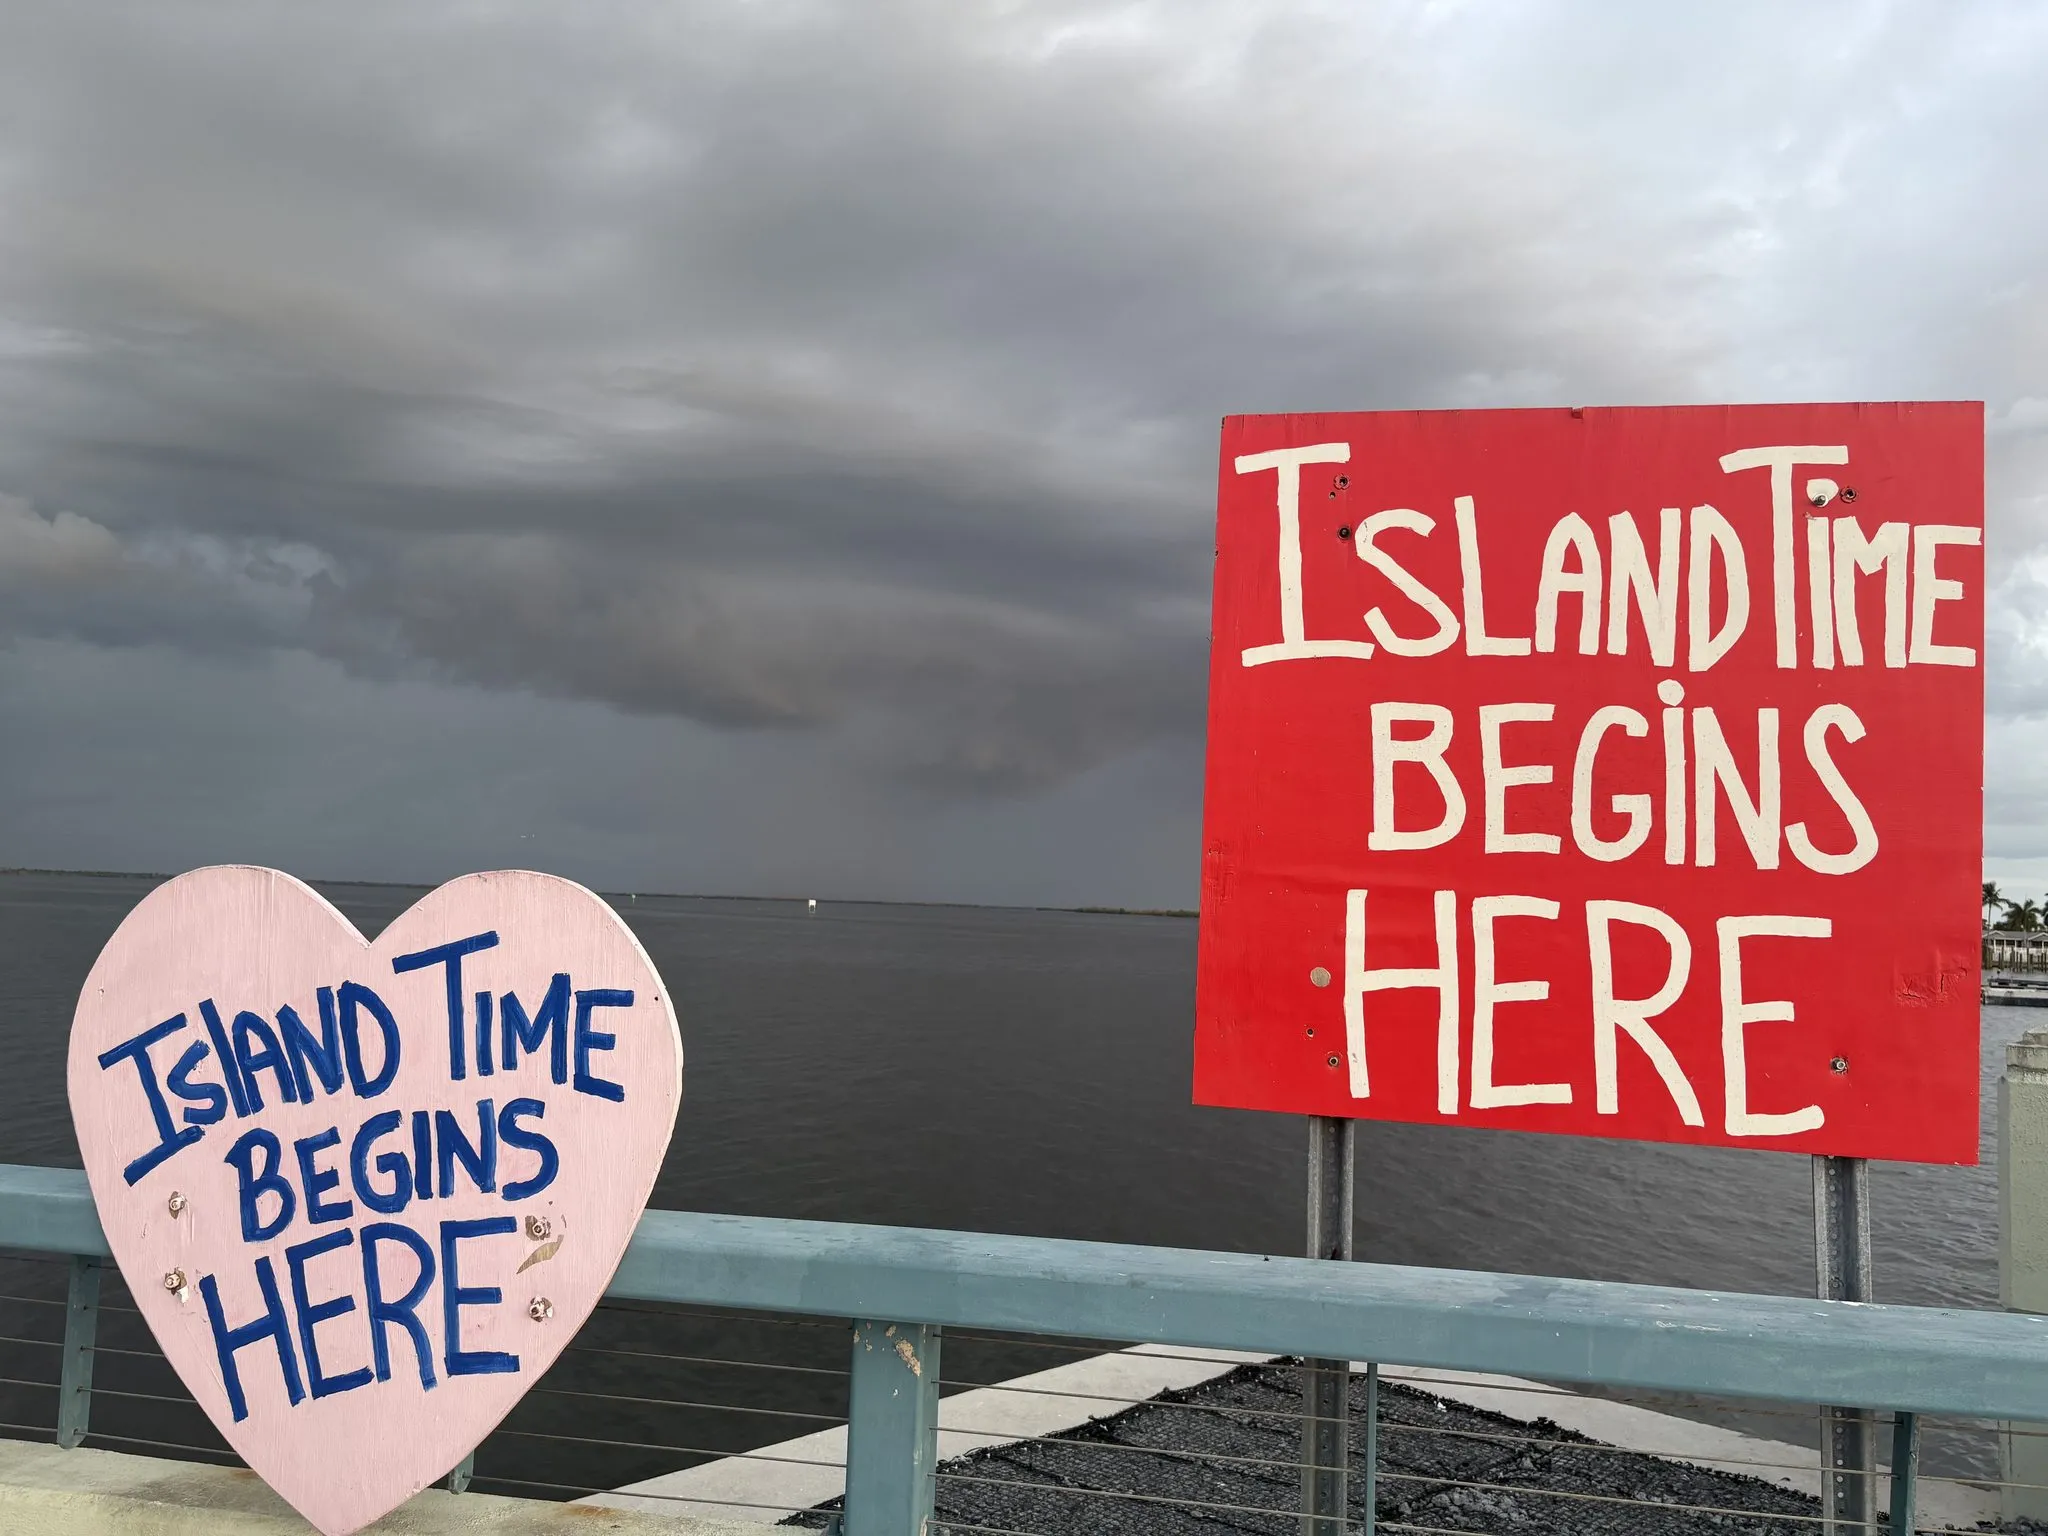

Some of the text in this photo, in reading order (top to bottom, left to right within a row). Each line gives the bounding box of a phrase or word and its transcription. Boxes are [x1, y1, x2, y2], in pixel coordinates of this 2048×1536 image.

[1234, 442, 1750, 673] ISLAND
[392, 931, 634, 1102] TIME
[1342, 888, 1832, 1138] HERE
[225, 1098, 560, 1243] BEGINS
[199, 1216, 521, 1423] HERE
